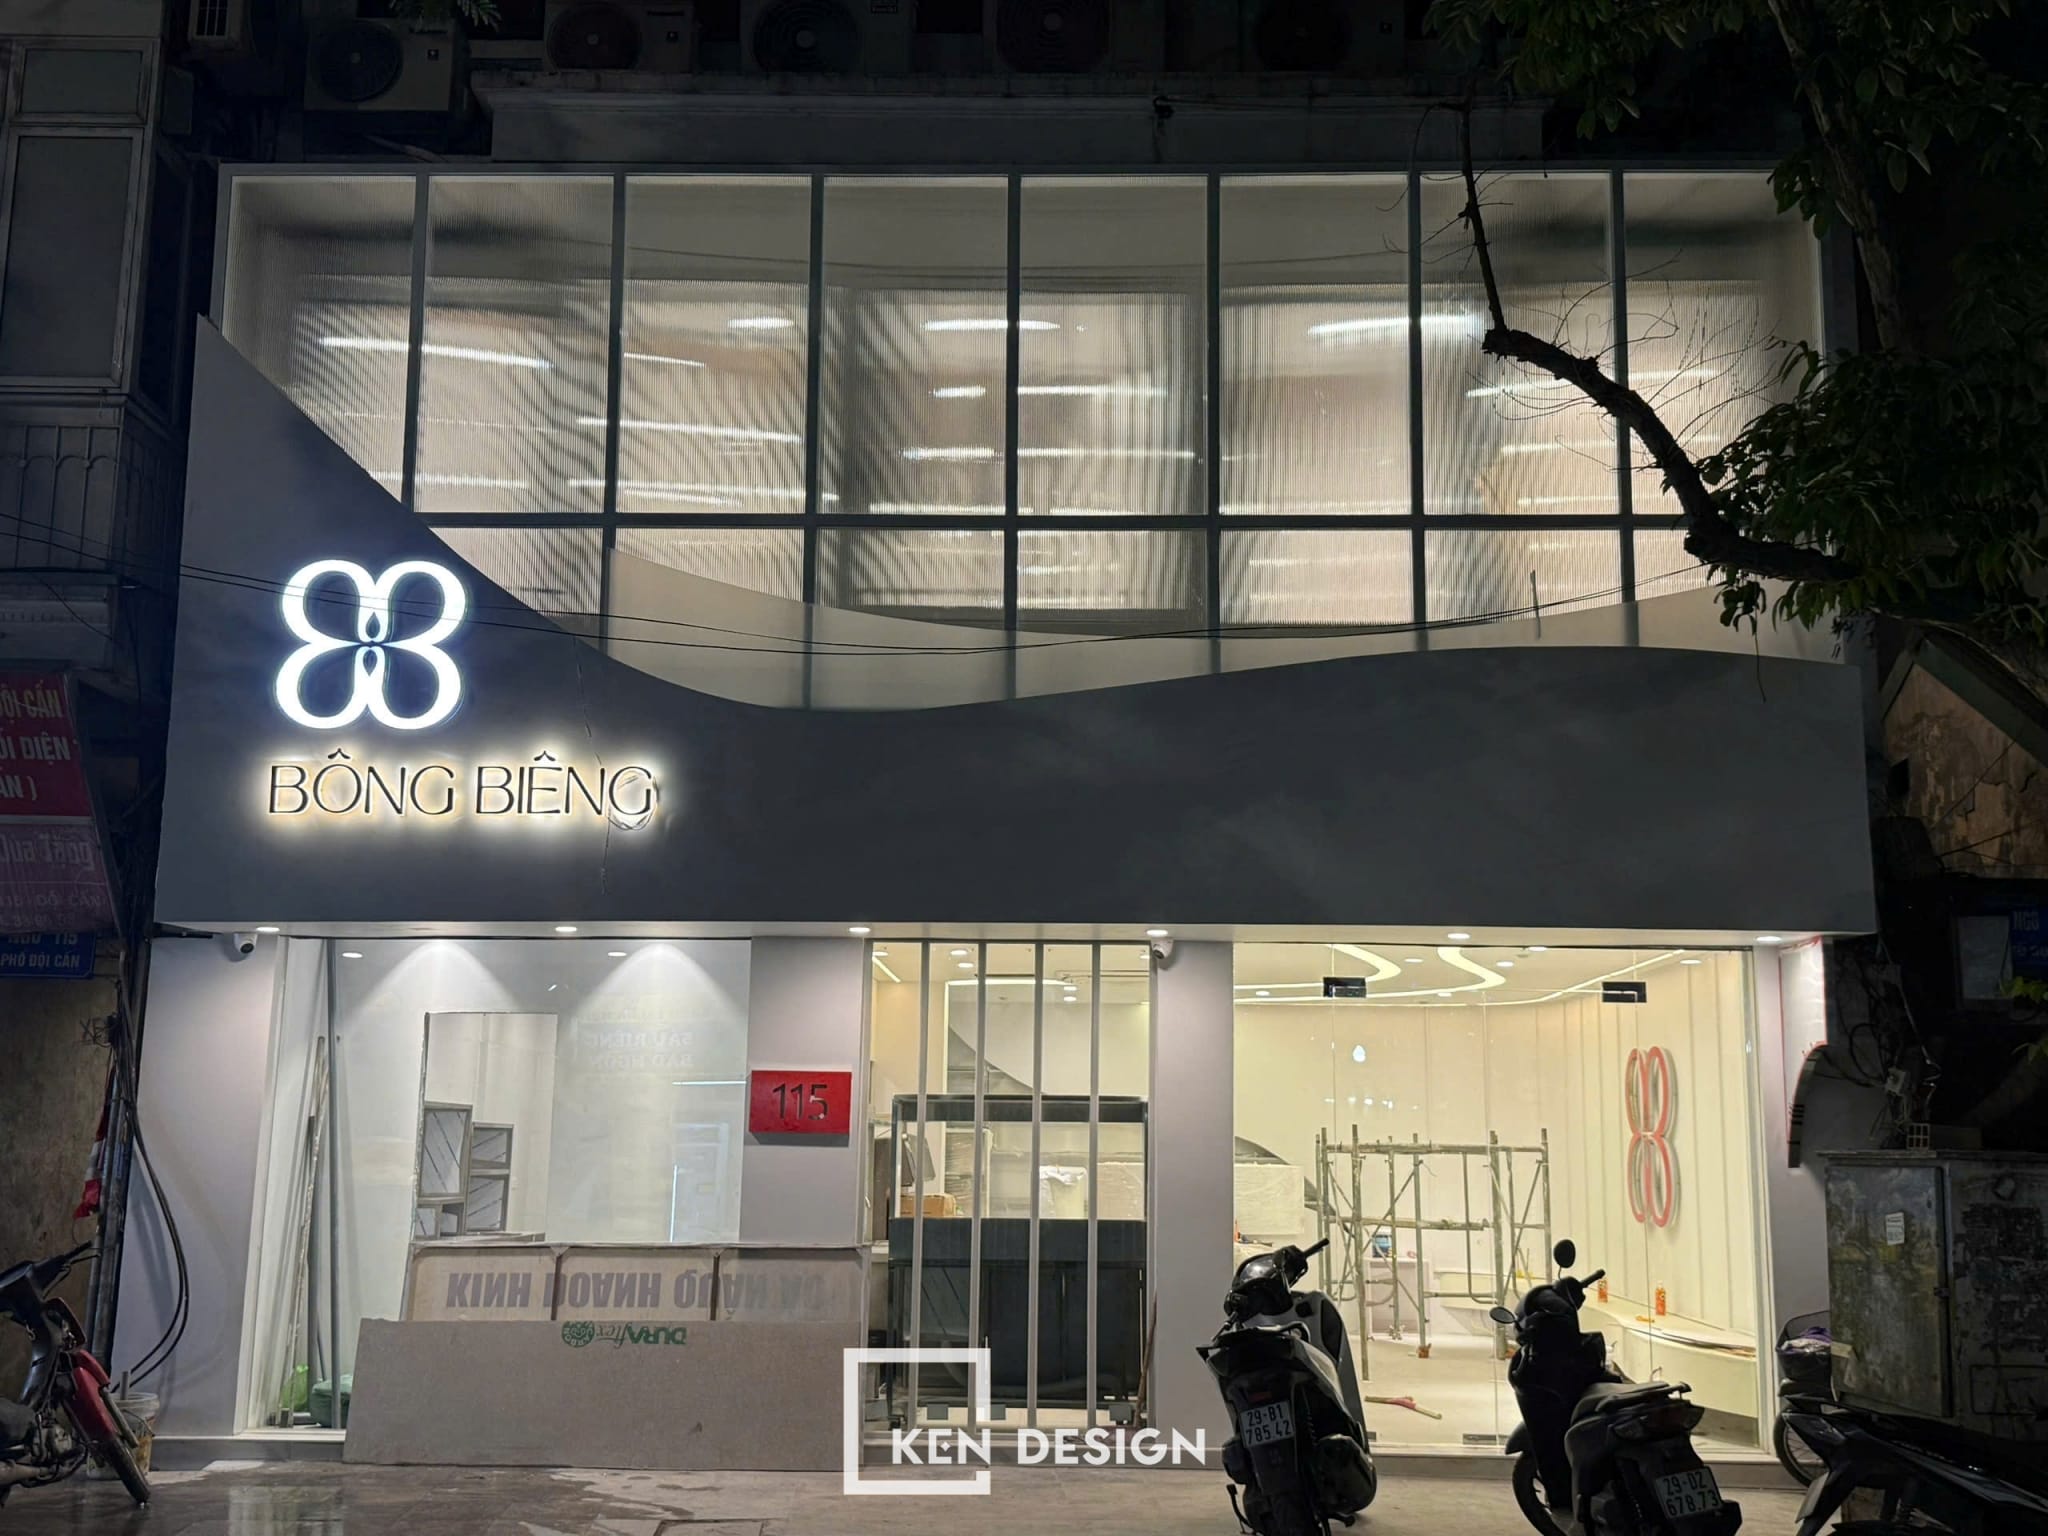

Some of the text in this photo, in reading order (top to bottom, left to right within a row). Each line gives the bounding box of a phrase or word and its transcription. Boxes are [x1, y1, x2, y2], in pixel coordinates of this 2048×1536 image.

[19, 730, 71, 766] DIỆN
[268, 747, 653, 817] BÔNG BIÊNG
[773, 1083, 829, 1121] 115
[1247, 1404, 1284, 1427] 29-B1
[1245, 1420, 1292, 1445] 785.42
[1665, 1490, 1719, 1516] 678.73
